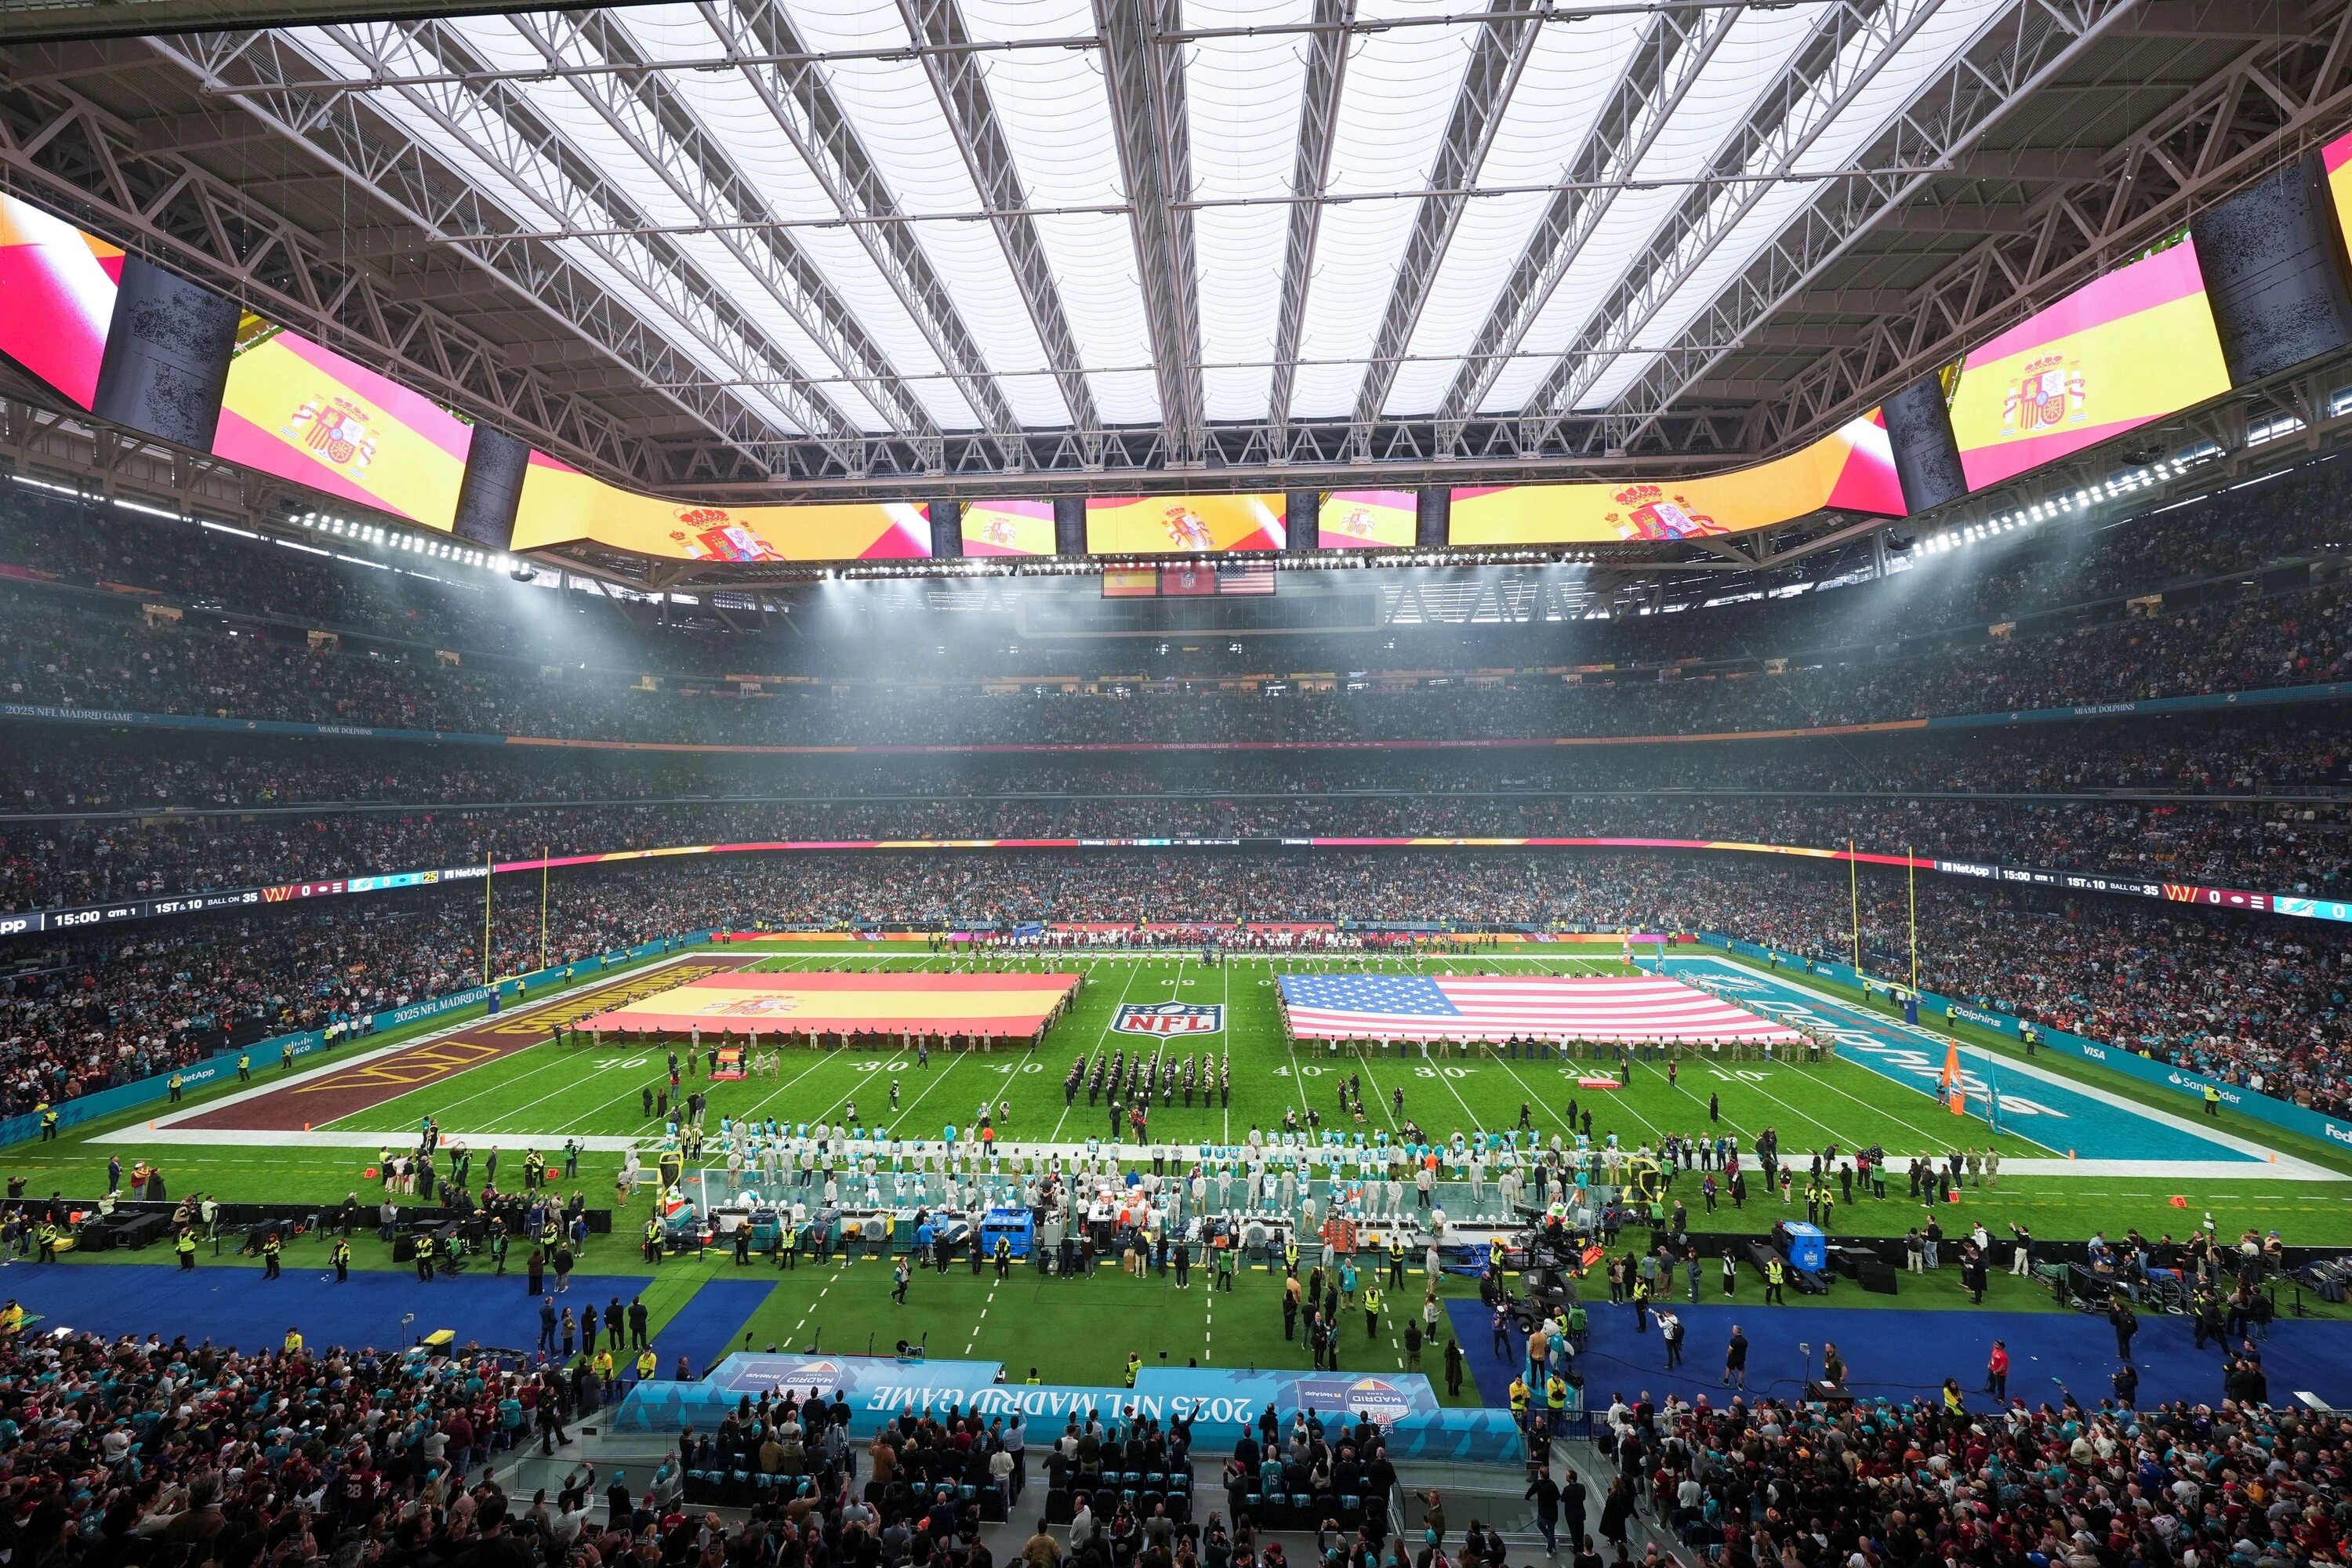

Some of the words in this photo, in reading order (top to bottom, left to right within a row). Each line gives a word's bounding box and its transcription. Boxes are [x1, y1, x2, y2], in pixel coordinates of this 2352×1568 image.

[6, 706, 34, 715] 2025
[37, 707, 57, 717] NFL
[60, 710, 102, 720] MADRID
[103, 712, 132, 721] GAME
[2074, 706, 2096, 715] MIAMI
[2099, 704, 2135, 713] DOLPHINS
[455, 867, 488, 878] NetApp
[1953, 863, 1989, 877] NetApp
[2003, 869, 2031, 881] 15:00
[423, 873, 437, 883] 25
[2067, 877, 2086, 887] 1ST
[2092, 880, 2106, 890] 10
[301, 885, 310, 896] 0
[2143, 885, 2158, 896] 35
[242, 892, 258, 902] 35
[2209, 891, 2220, 903] 0
[155, 902, 180, 913] 1ST
[187, 900, 202, 909] 10
[2332, 904, 2346, 918] 0
[55, 911, 100, 927] 15:00
[107, 909, 127, 918] QTR
[0, 920, 27, 934] pp
[1817, 966, 1833, 976] Adobe
[394, 1007, 419, 1023] 2025
[420, 1004, 439, 1016] NFL
[440, 993, 475, 1010] MADRID
[1955, 1005, 2002, 1027] Dolphins
[1123, 1015, 1210, 1033] NFL
[1836, 1004, 1882, 1017] END
[1878, 1018, 1971, 1047] RACISM
[292, 1044, 310, 1055] isco
[2082, 1044, 2106, 1060] VISA
[593, 1058, 648, 1069] 10
[856, 1061, 909, 1072] 30
[993, 1062, 1043, 1073] 40
[1272, 1065, 1322, 1076] 40
[1414, 1067, 1466, 1078] 30
[1558, 1069, 1613, 1080] 20
[1708, 1070, 1763, 1081] 10
[1204, 1147, 1207, 1156] 1
[2177, 1198, 2185, 1207] G
[866, 1385, 964, 1414] GAME
[969, 1388, 1103, 1417] MADRID
[1109, 1393, 1164, 1420] NFL
[1171, 1395, 1253, 1424] 2025
[1373, 1414, 1389, 1424] NFL
[1267, 1475, 1278, 1486] 15
[347, 1483, 362, 1498] 28
